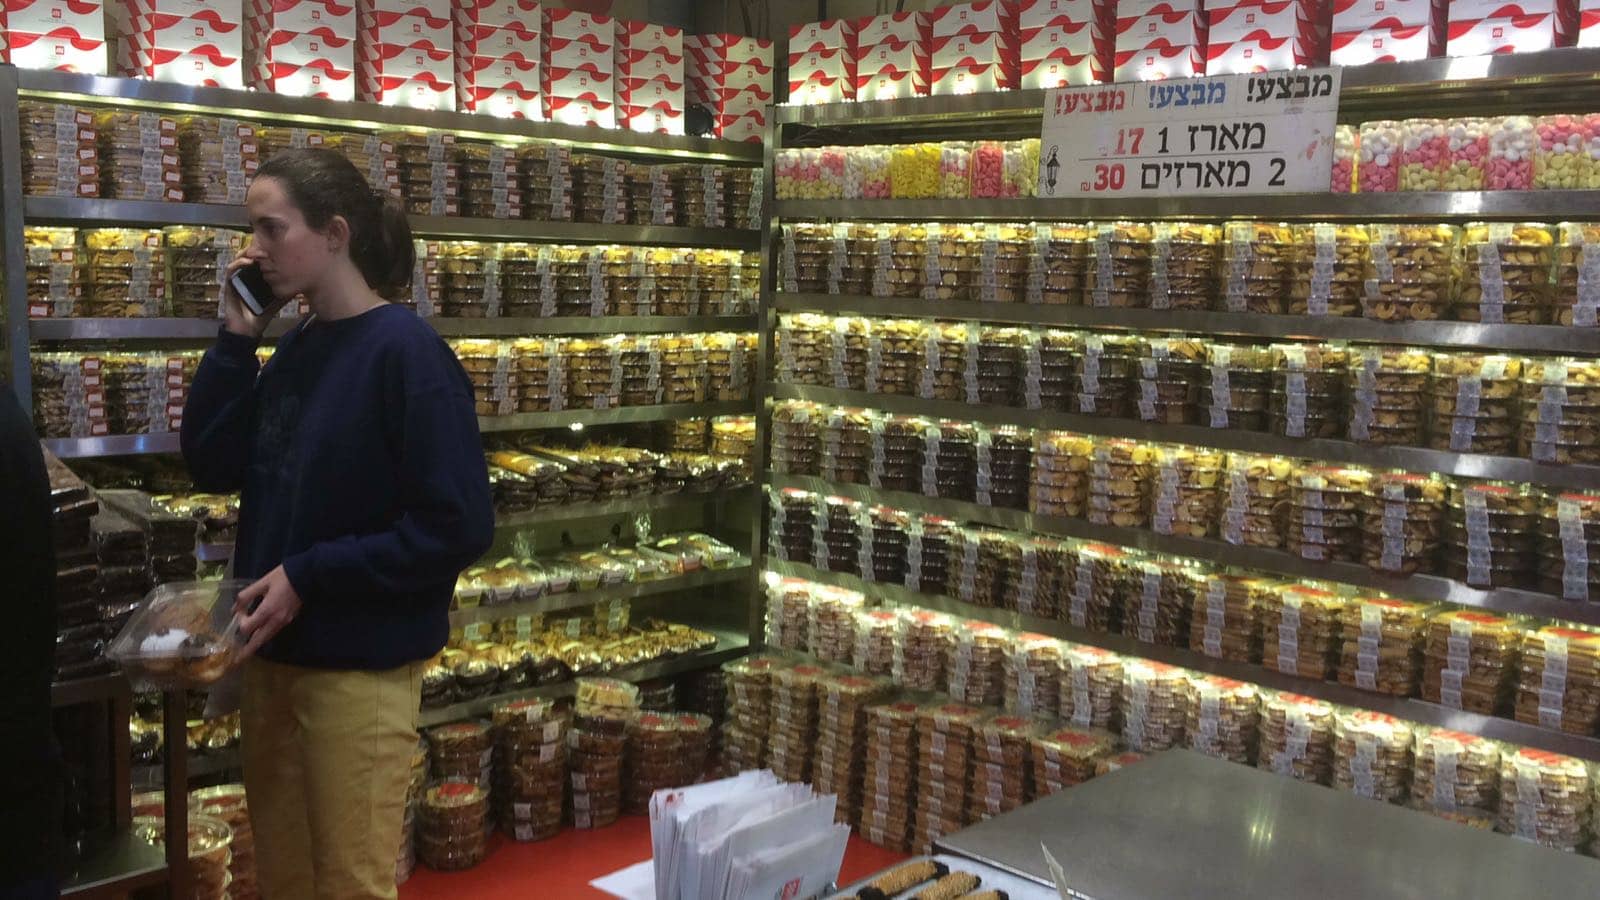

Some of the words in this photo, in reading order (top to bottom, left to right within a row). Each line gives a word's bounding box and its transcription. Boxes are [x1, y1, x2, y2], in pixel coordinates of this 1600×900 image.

[1148, 82, 1226, 109] מבצע!
[1247, 73, 1333, 103] מבצע!
[1056, 90, 1126, 115] מבצע!
[1113, 127, 1145, 155] 17
[1158, 126, 1169, 154] 1
[1187, 122, 1266, 152] מארז
[1141, 160, 1251, 190] מארזים
[1268, 157, 1286, 186] 2
